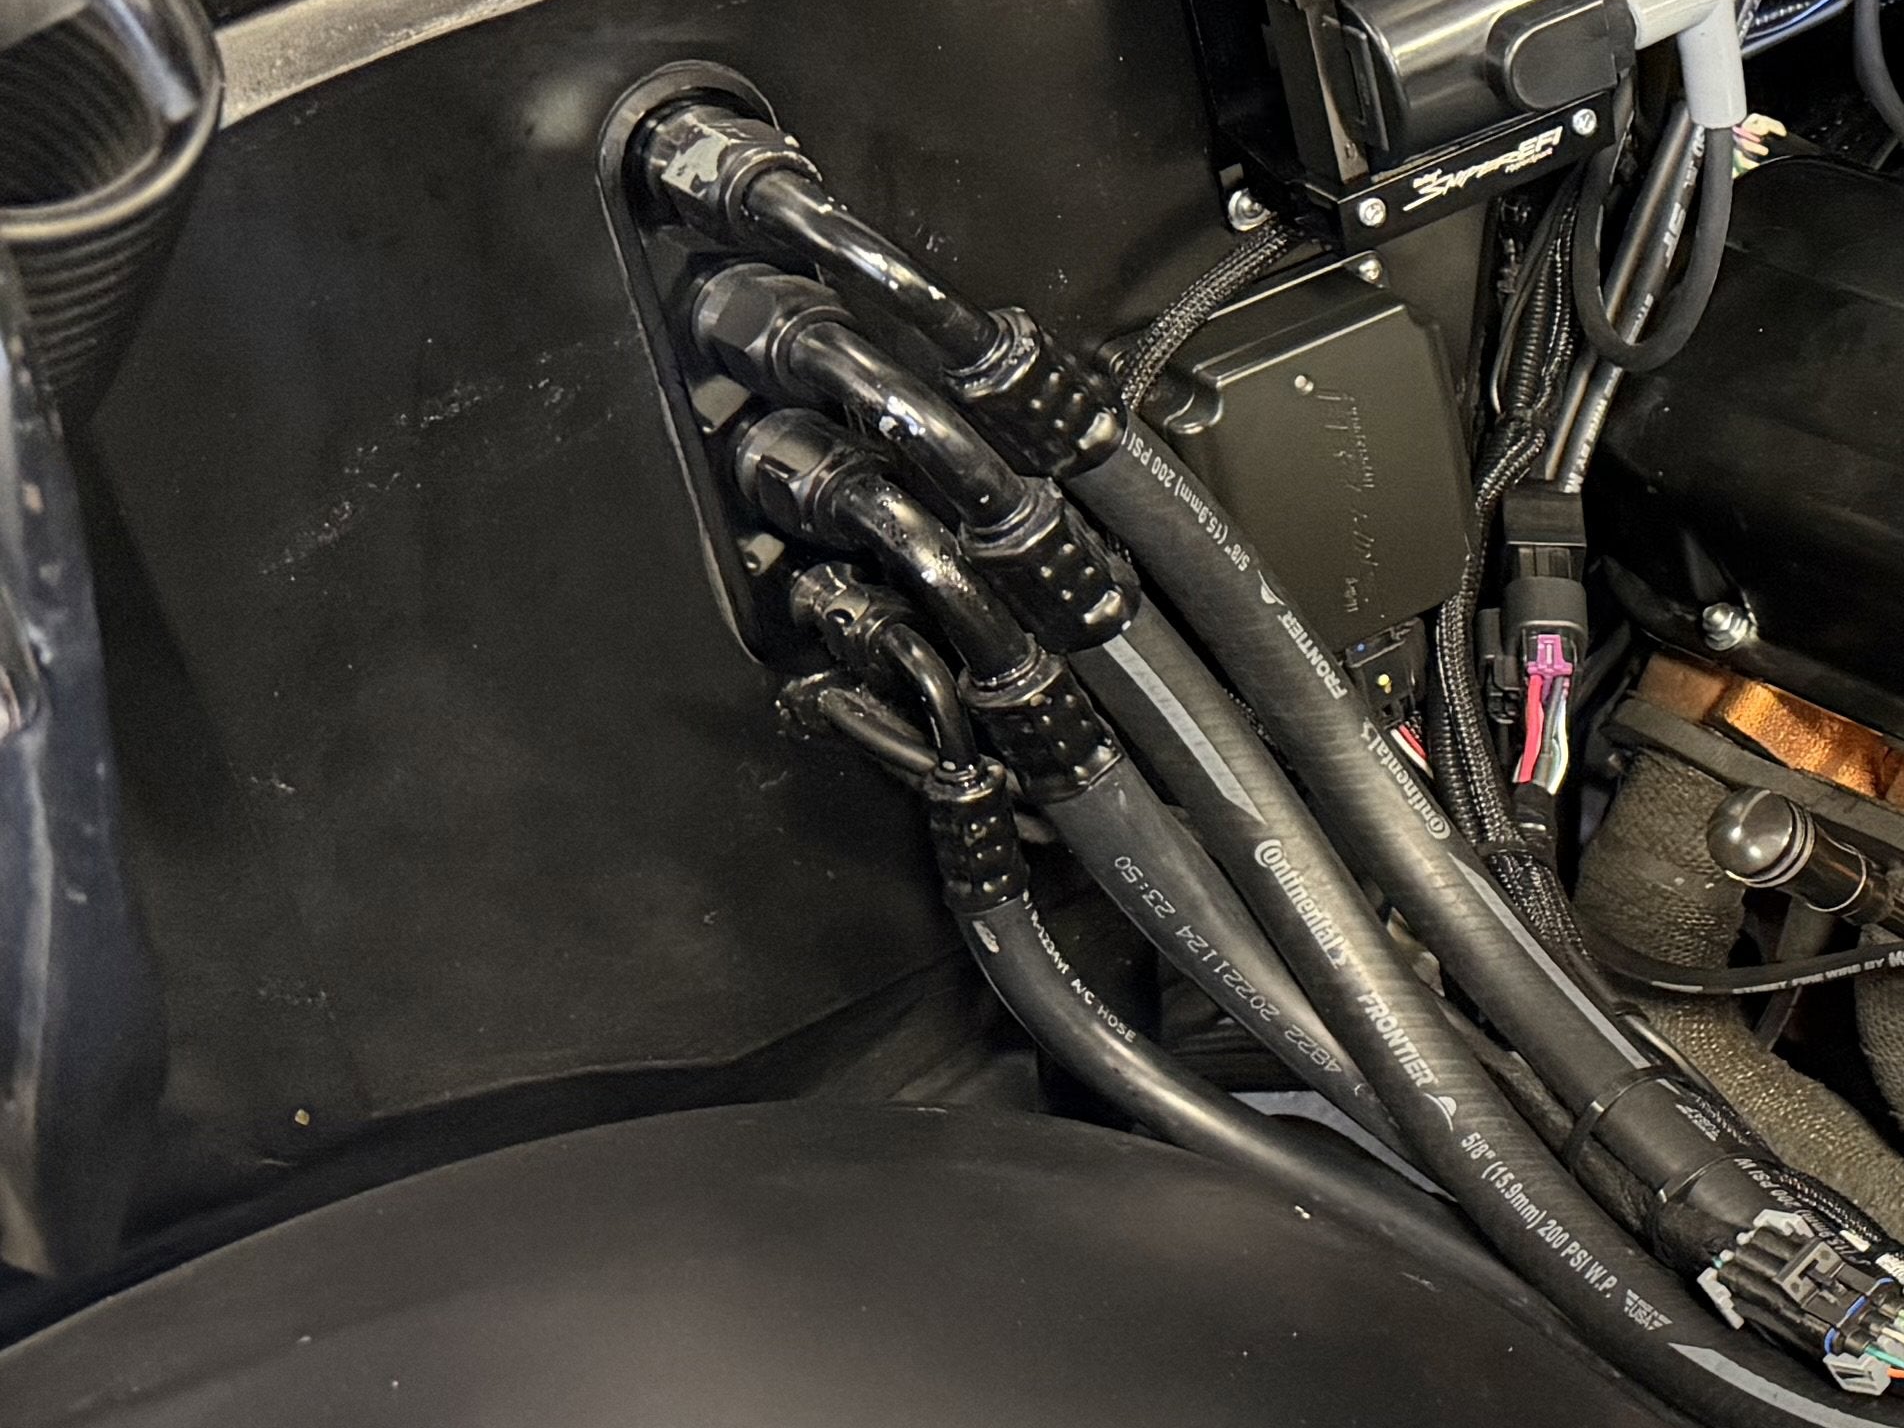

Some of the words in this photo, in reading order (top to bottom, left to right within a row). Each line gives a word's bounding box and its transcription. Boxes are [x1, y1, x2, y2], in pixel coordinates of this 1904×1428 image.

[1123, 432, 1156, 466] PSI
[1146, 455, 1179, 489] 200
[1166, 475, 1233, 545] (15.9mm)
[1222, 539, 1254, 571] 5/8"
[1271, 609, 1354, 700] FRONTIER
[1361, 732, 1456, 843] Continental
[1105, 852, 1183, 923] 23:50
[1249, 832, 1350, 954] Continental
[1170, 921, 1285, 1024] 20221124
[1069, 976, 1097, 1006] A/C
[1095, 1000, 1139, 1048] HOSE
[1349, 985, 1443, 1091] FRONTIER
[1283, 1022, 1344, 1078] 4822
[1458, 1129, 1497, 1168] 5/8"
[1477, 1157, 1549, 1231] (15.9mm)
[1536, 1215, 1570, 1250] 200
[1559, 1238, 1593, 1272] PSI
[1581, 1258, 1622, 1300] W.P.
